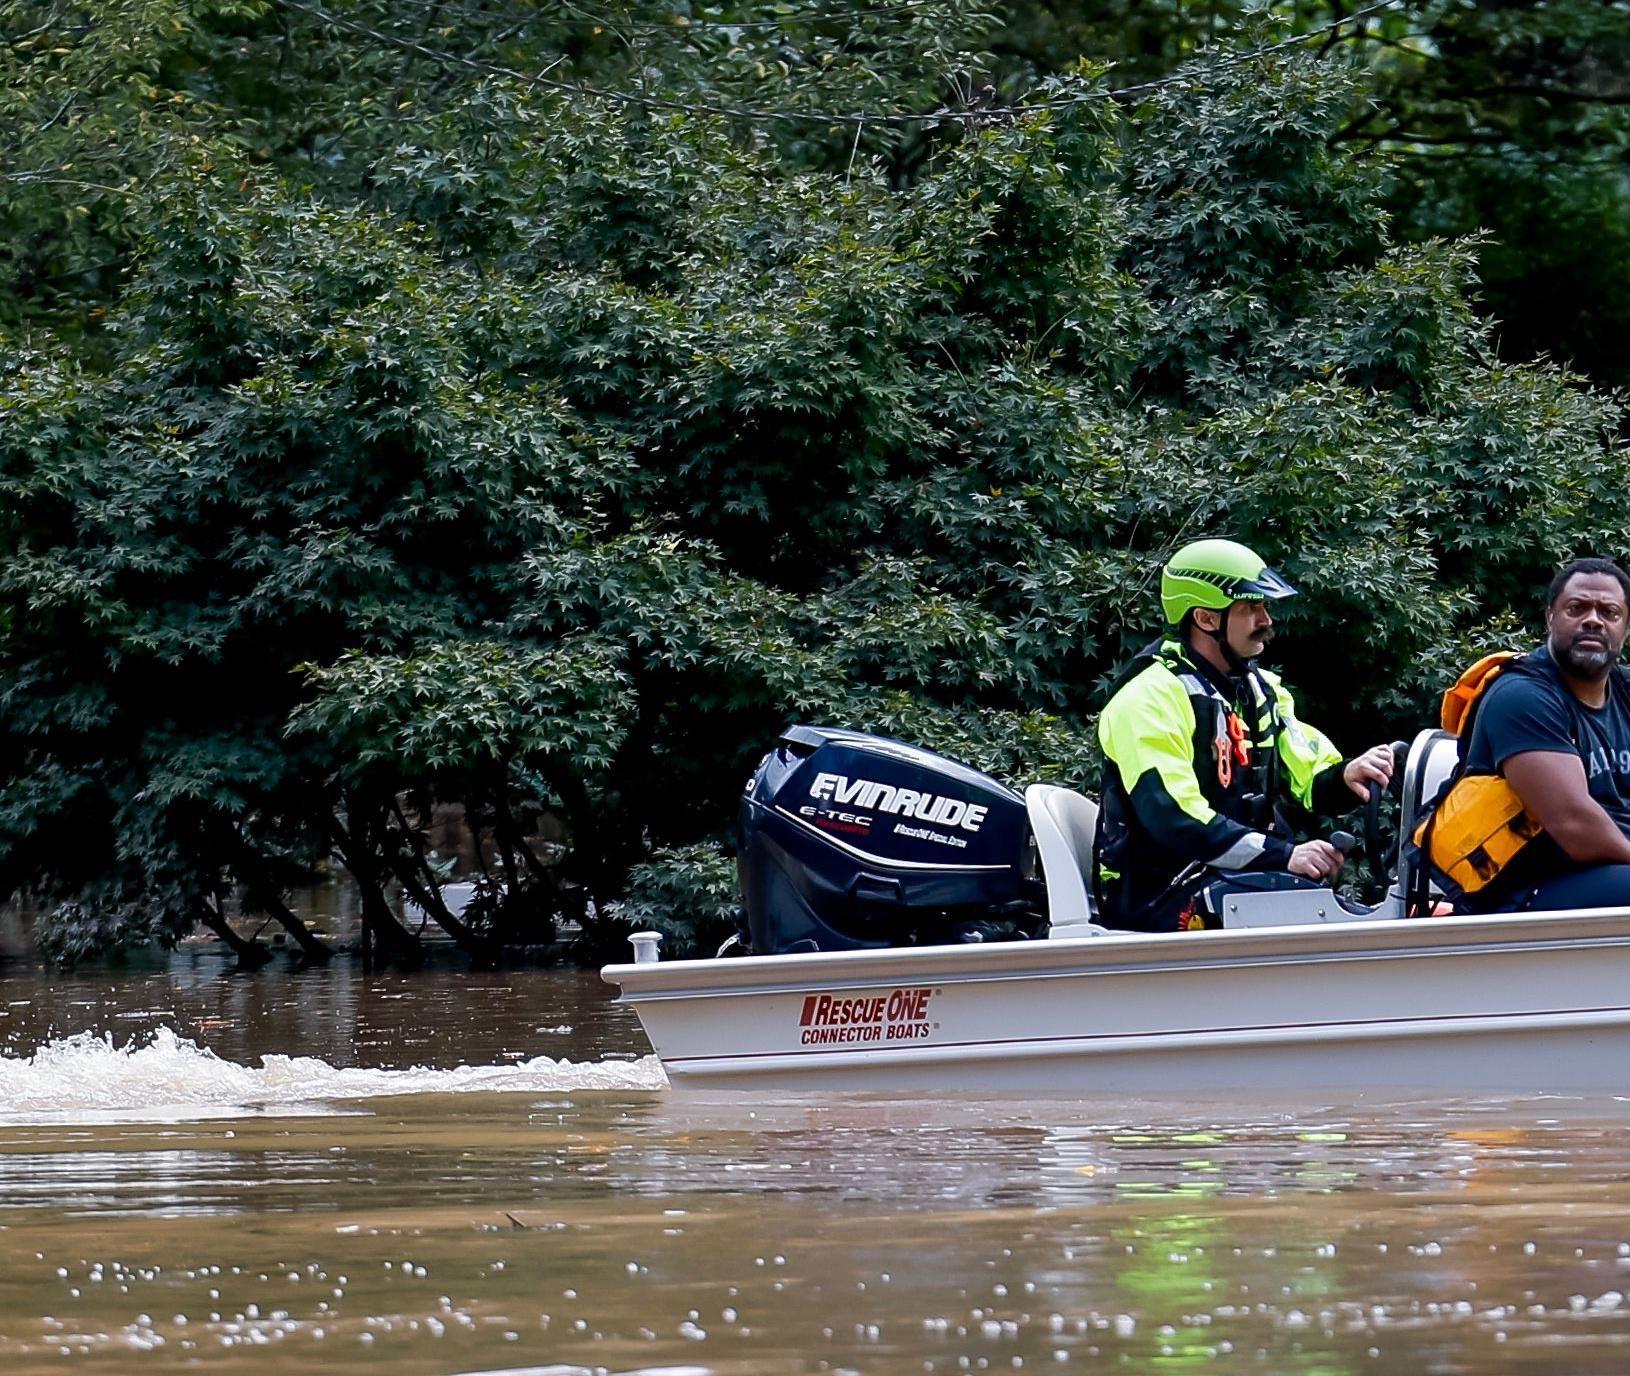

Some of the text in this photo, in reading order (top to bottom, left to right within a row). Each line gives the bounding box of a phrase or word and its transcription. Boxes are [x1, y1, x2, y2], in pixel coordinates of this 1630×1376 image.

[809, 772, 988, 832] EVINRUDE
[799, 806, 873, 827] E-TEC
[801, 1022, 930, 1045] CONNECTOR BOATS
